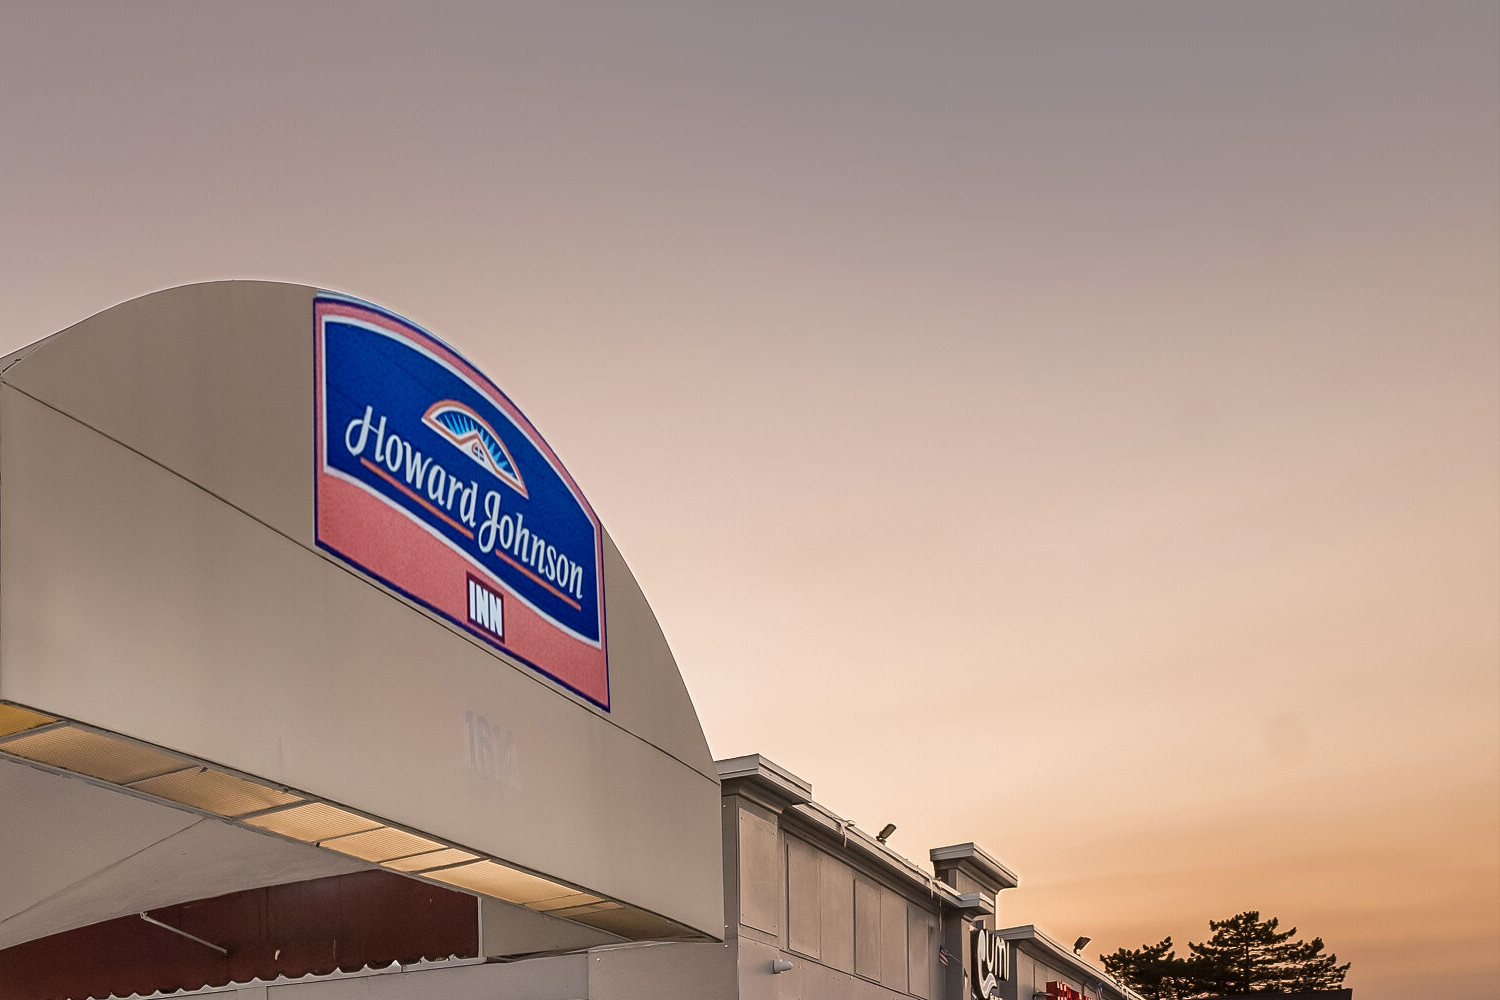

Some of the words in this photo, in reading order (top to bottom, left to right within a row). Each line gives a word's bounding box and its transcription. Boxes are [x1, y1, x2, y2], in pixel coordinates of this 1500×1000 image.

[345, 405, 476, 528] Howard
[479, 490, 584, 599] Johnson
[468, 579, 503, 637] INN
